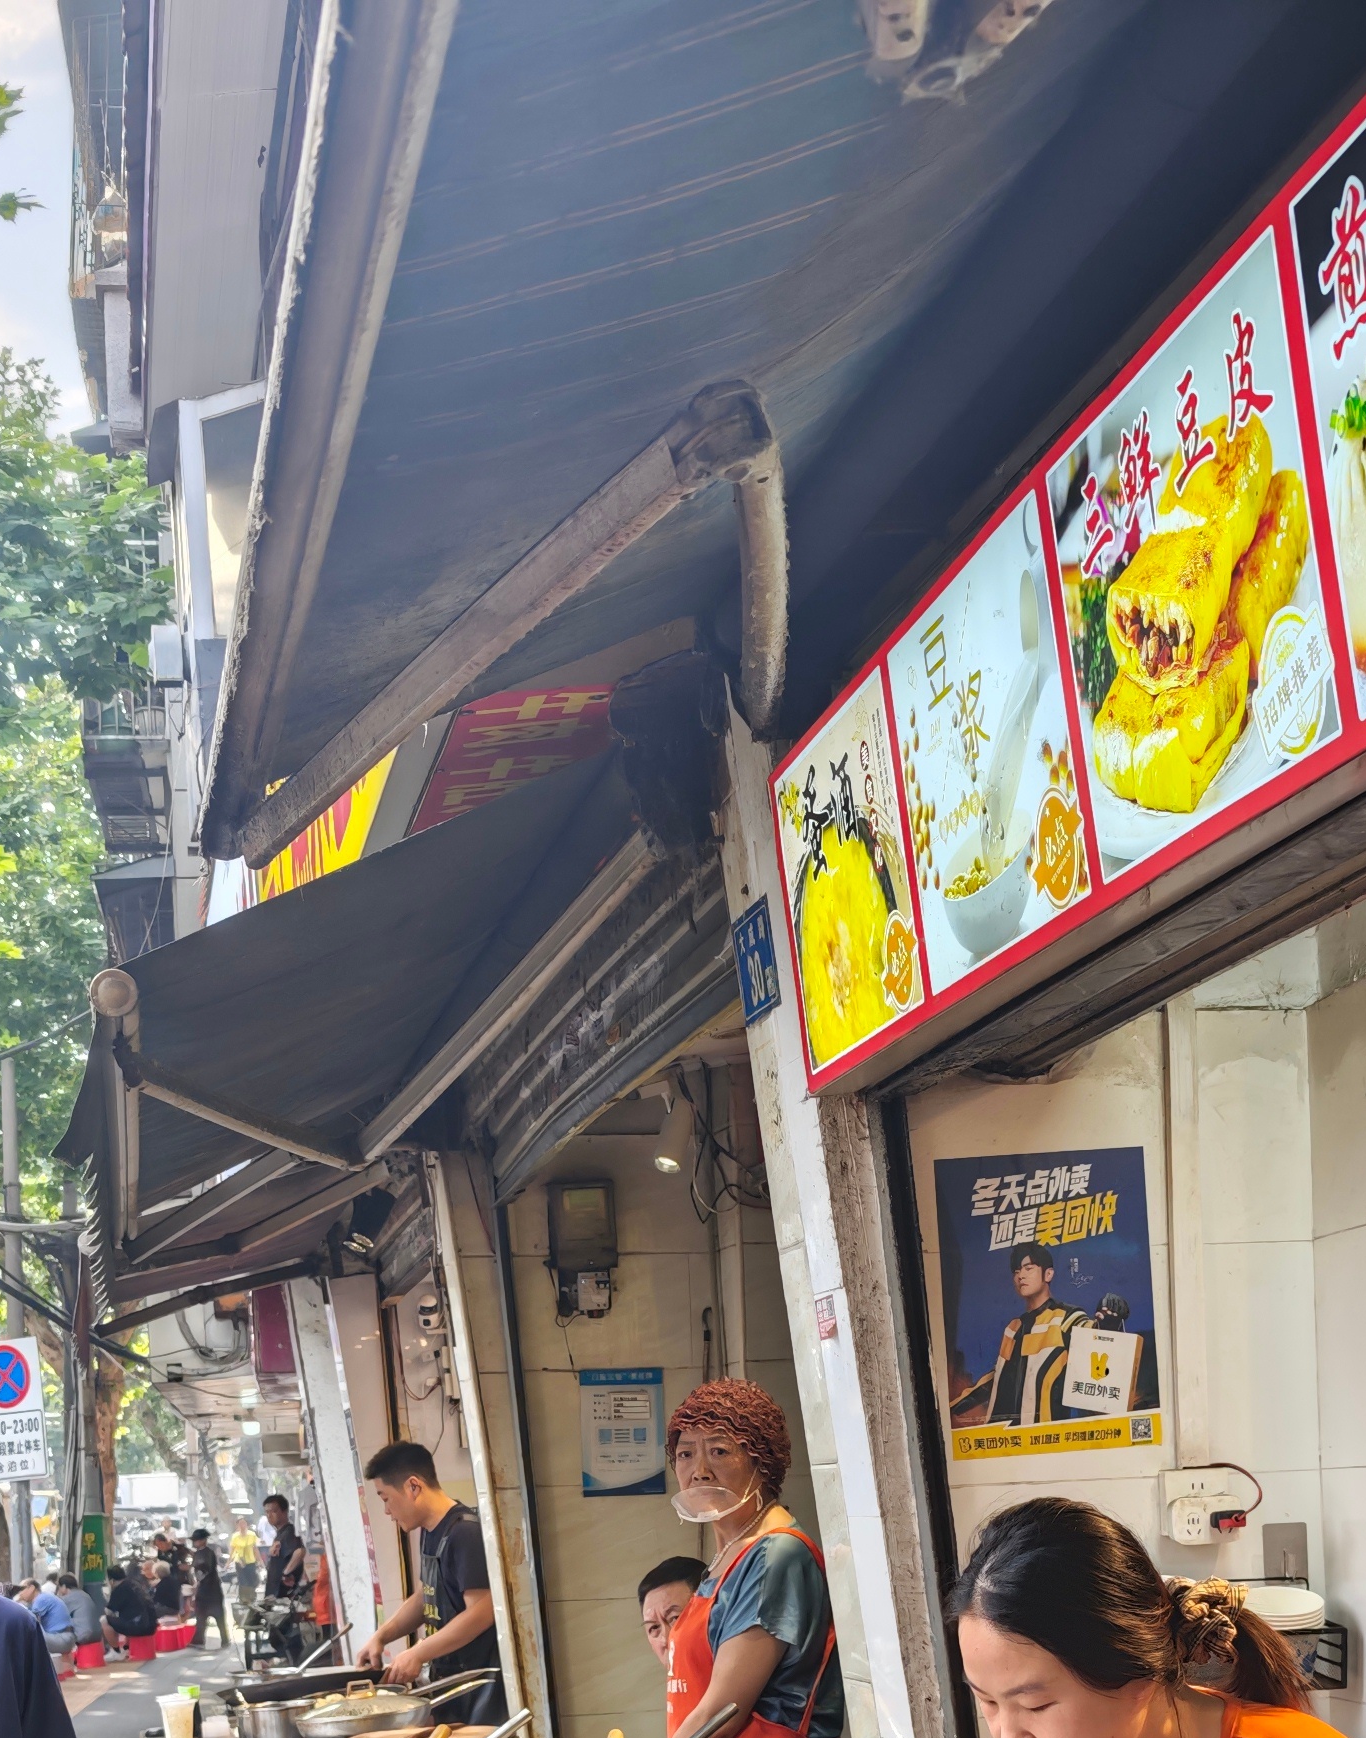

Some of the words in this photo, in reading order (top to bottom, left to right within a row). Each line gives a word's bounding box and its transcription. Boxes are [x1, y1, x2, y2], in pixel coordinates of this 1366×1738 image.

[1079, 308, 1275, 577] 三鲜豆皮
[919, 613, 991, 767] 豆浆
[1262, 633, 1325, 735] 招牌推荐
[970, 1162, 1093, 1218] 冬天点外卖
[987, 1190, 1120, 1252] 还是美团快
[1071, 1380, 1121, 1401] 美团外卖
[973, 1434, 1023, 1451] 美团外卖
